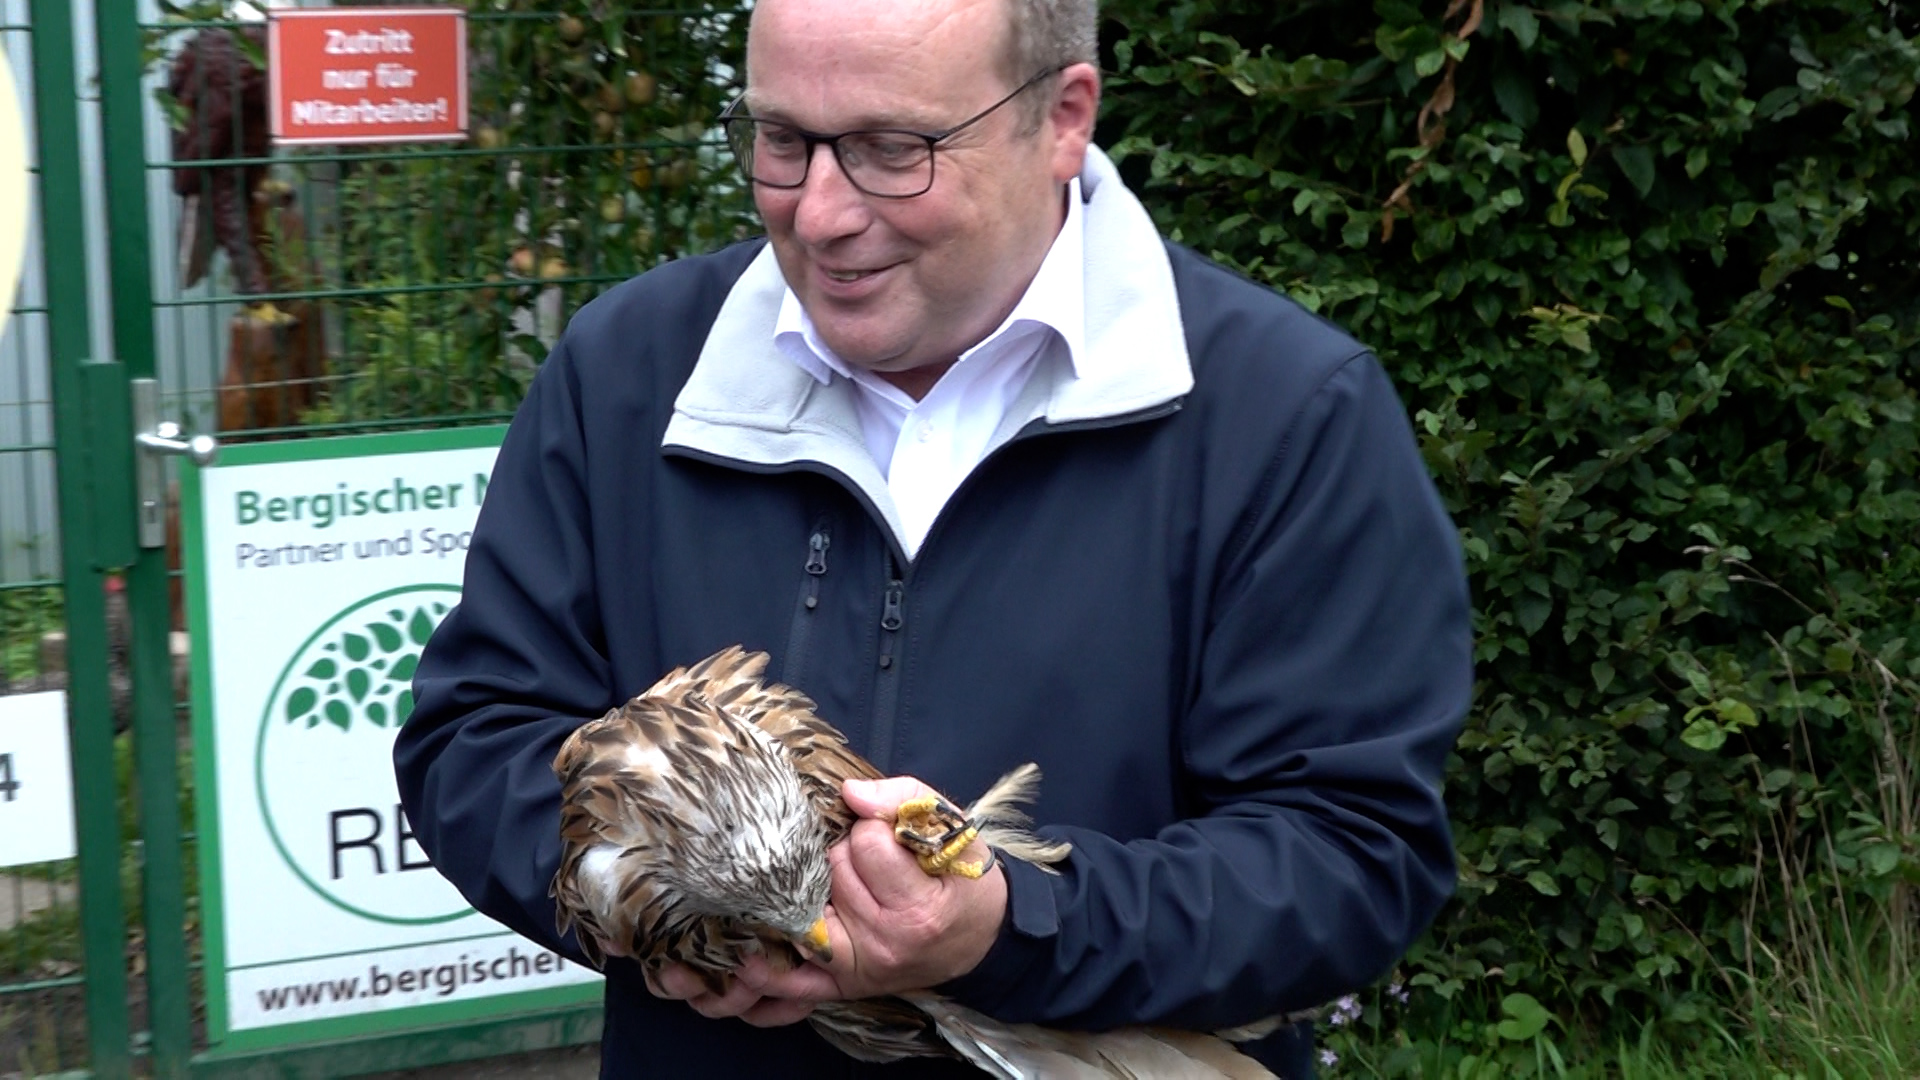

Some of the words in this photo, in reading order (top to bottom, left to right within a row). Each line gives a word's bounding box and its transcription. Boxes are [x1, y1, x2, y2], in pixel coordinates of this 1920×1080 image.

[323, 28, 414, 54] Zutritt
[321, 69, 372, 89] nur
[375, 62, 418, 88] für
[291, 98, 448, 125] Mitarbeiter!
[235, 478, 463, 528] Bergischer
[235, 541, 347, 568] Partner
[353, 529, 413, 560] und
